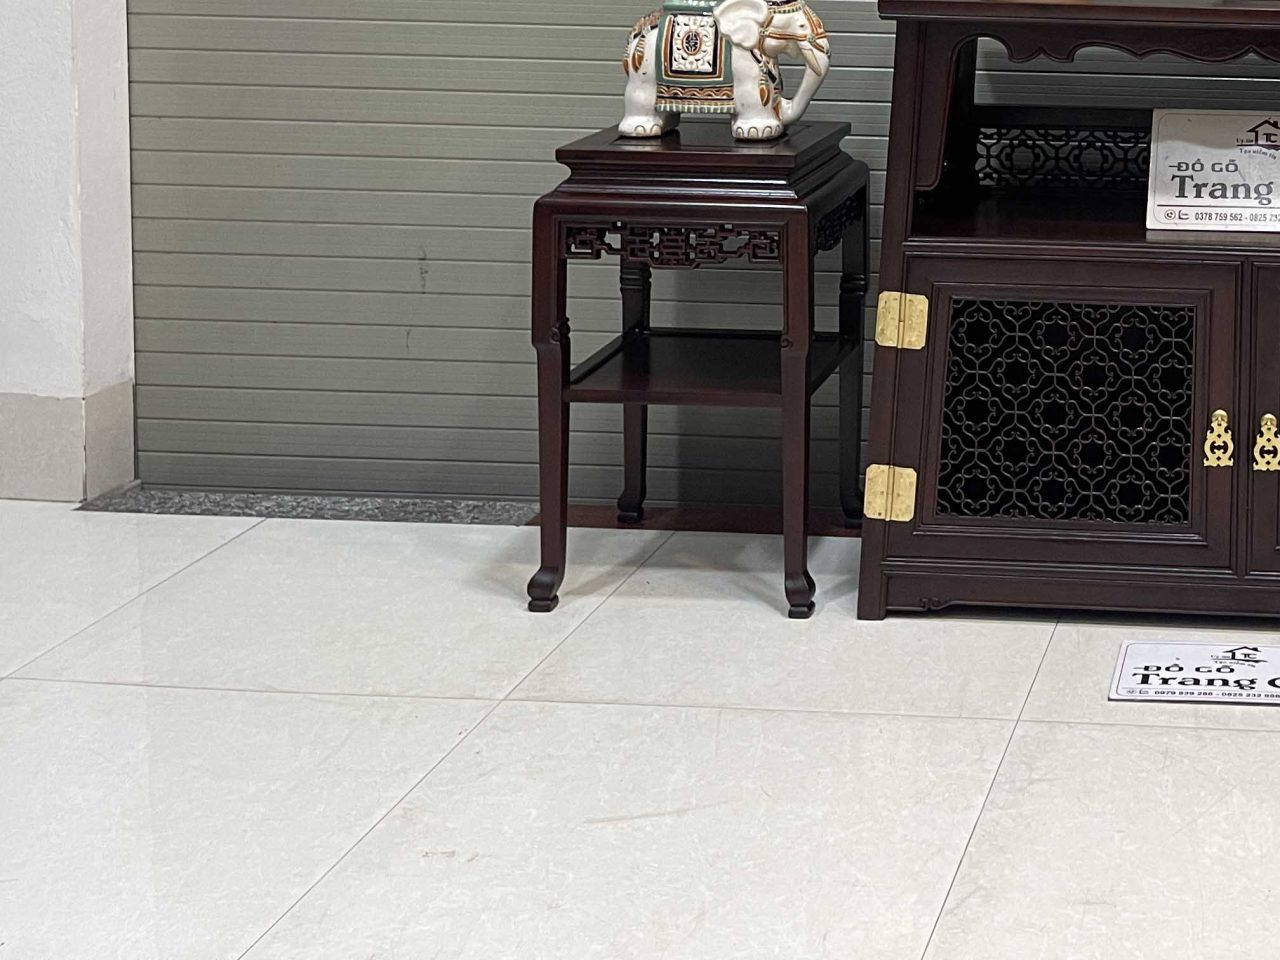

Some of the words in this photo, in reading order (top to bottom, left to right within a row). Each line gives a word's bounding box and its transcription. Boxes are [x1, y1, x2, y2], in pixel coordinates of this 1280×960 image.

[1170, 174, 1274, 206] Trang
[1194, 211, 1213, 221] 0378
[1214, 212, 1228, 222] 759
[1229, 212, 1243, 222] 562
[1132, 672, 1258, 690] Trang
